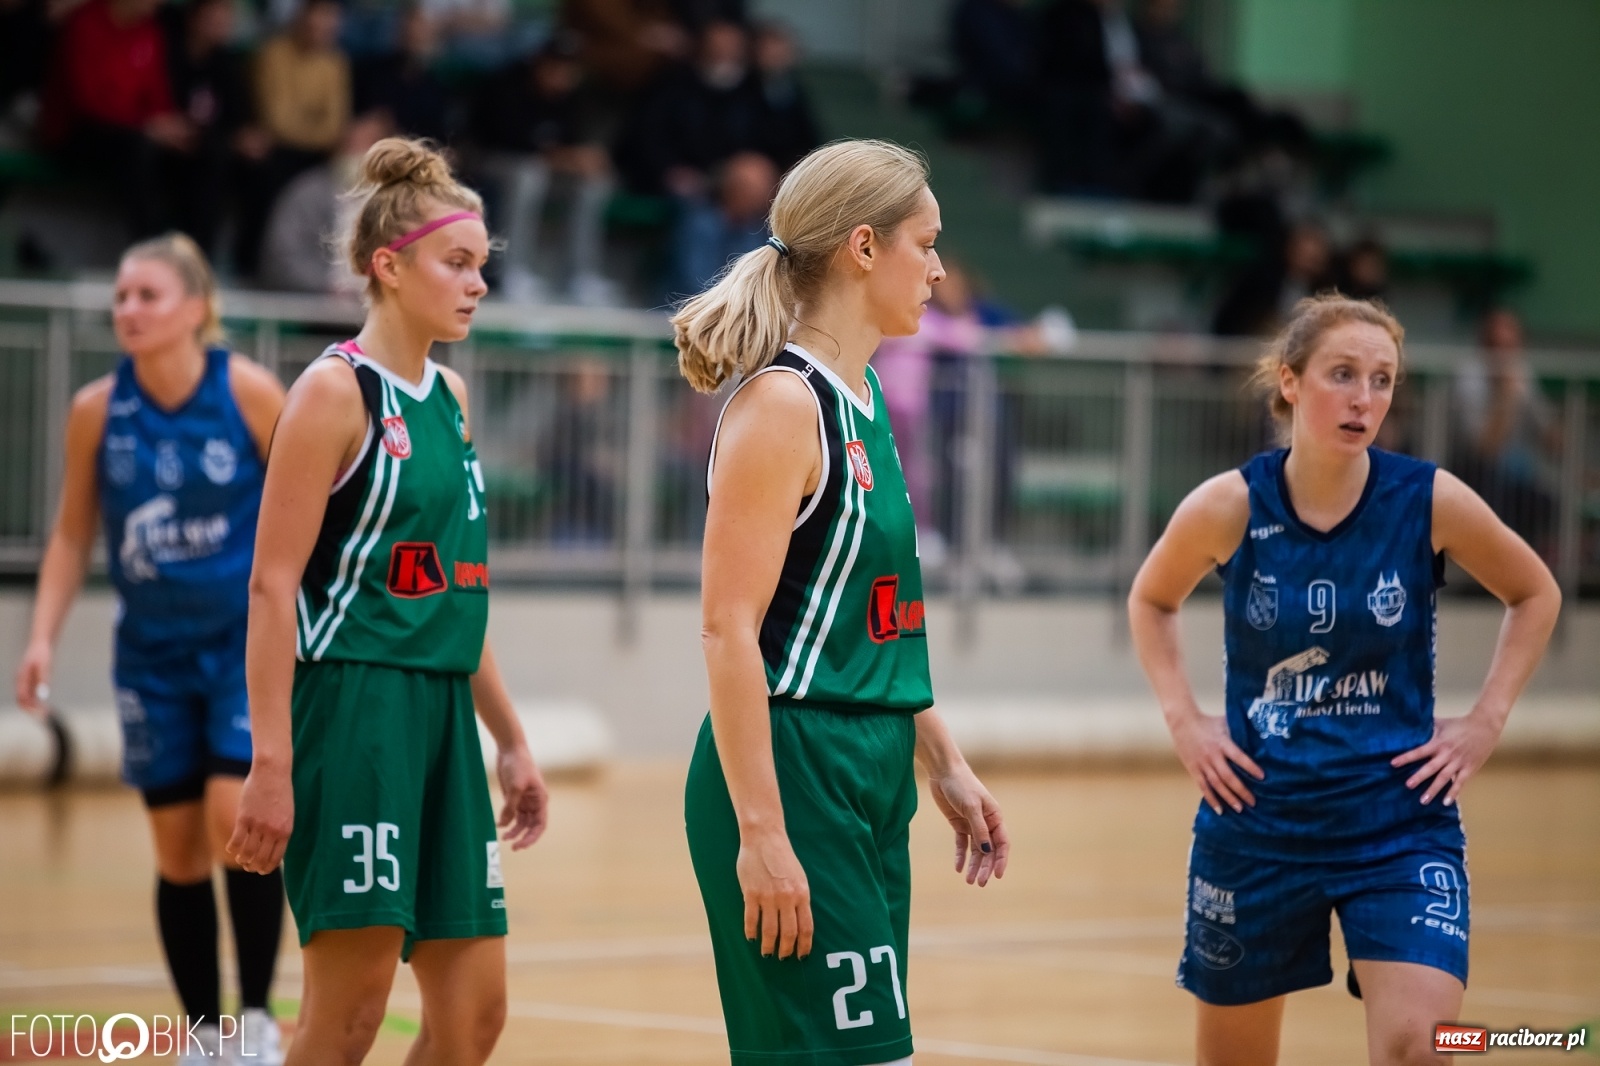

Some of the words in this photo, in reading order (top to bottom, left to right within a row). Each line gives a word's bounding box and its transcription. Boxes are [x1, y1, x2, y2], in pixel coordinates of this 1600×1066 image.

[1250, 524, 1285, 539] egio
[1308, 579, 1336, 634] 9
[341, 822, 400, 893] 35
[1419, 861, 1461, 920] 9
[825, 944, 906, 1030] 27
